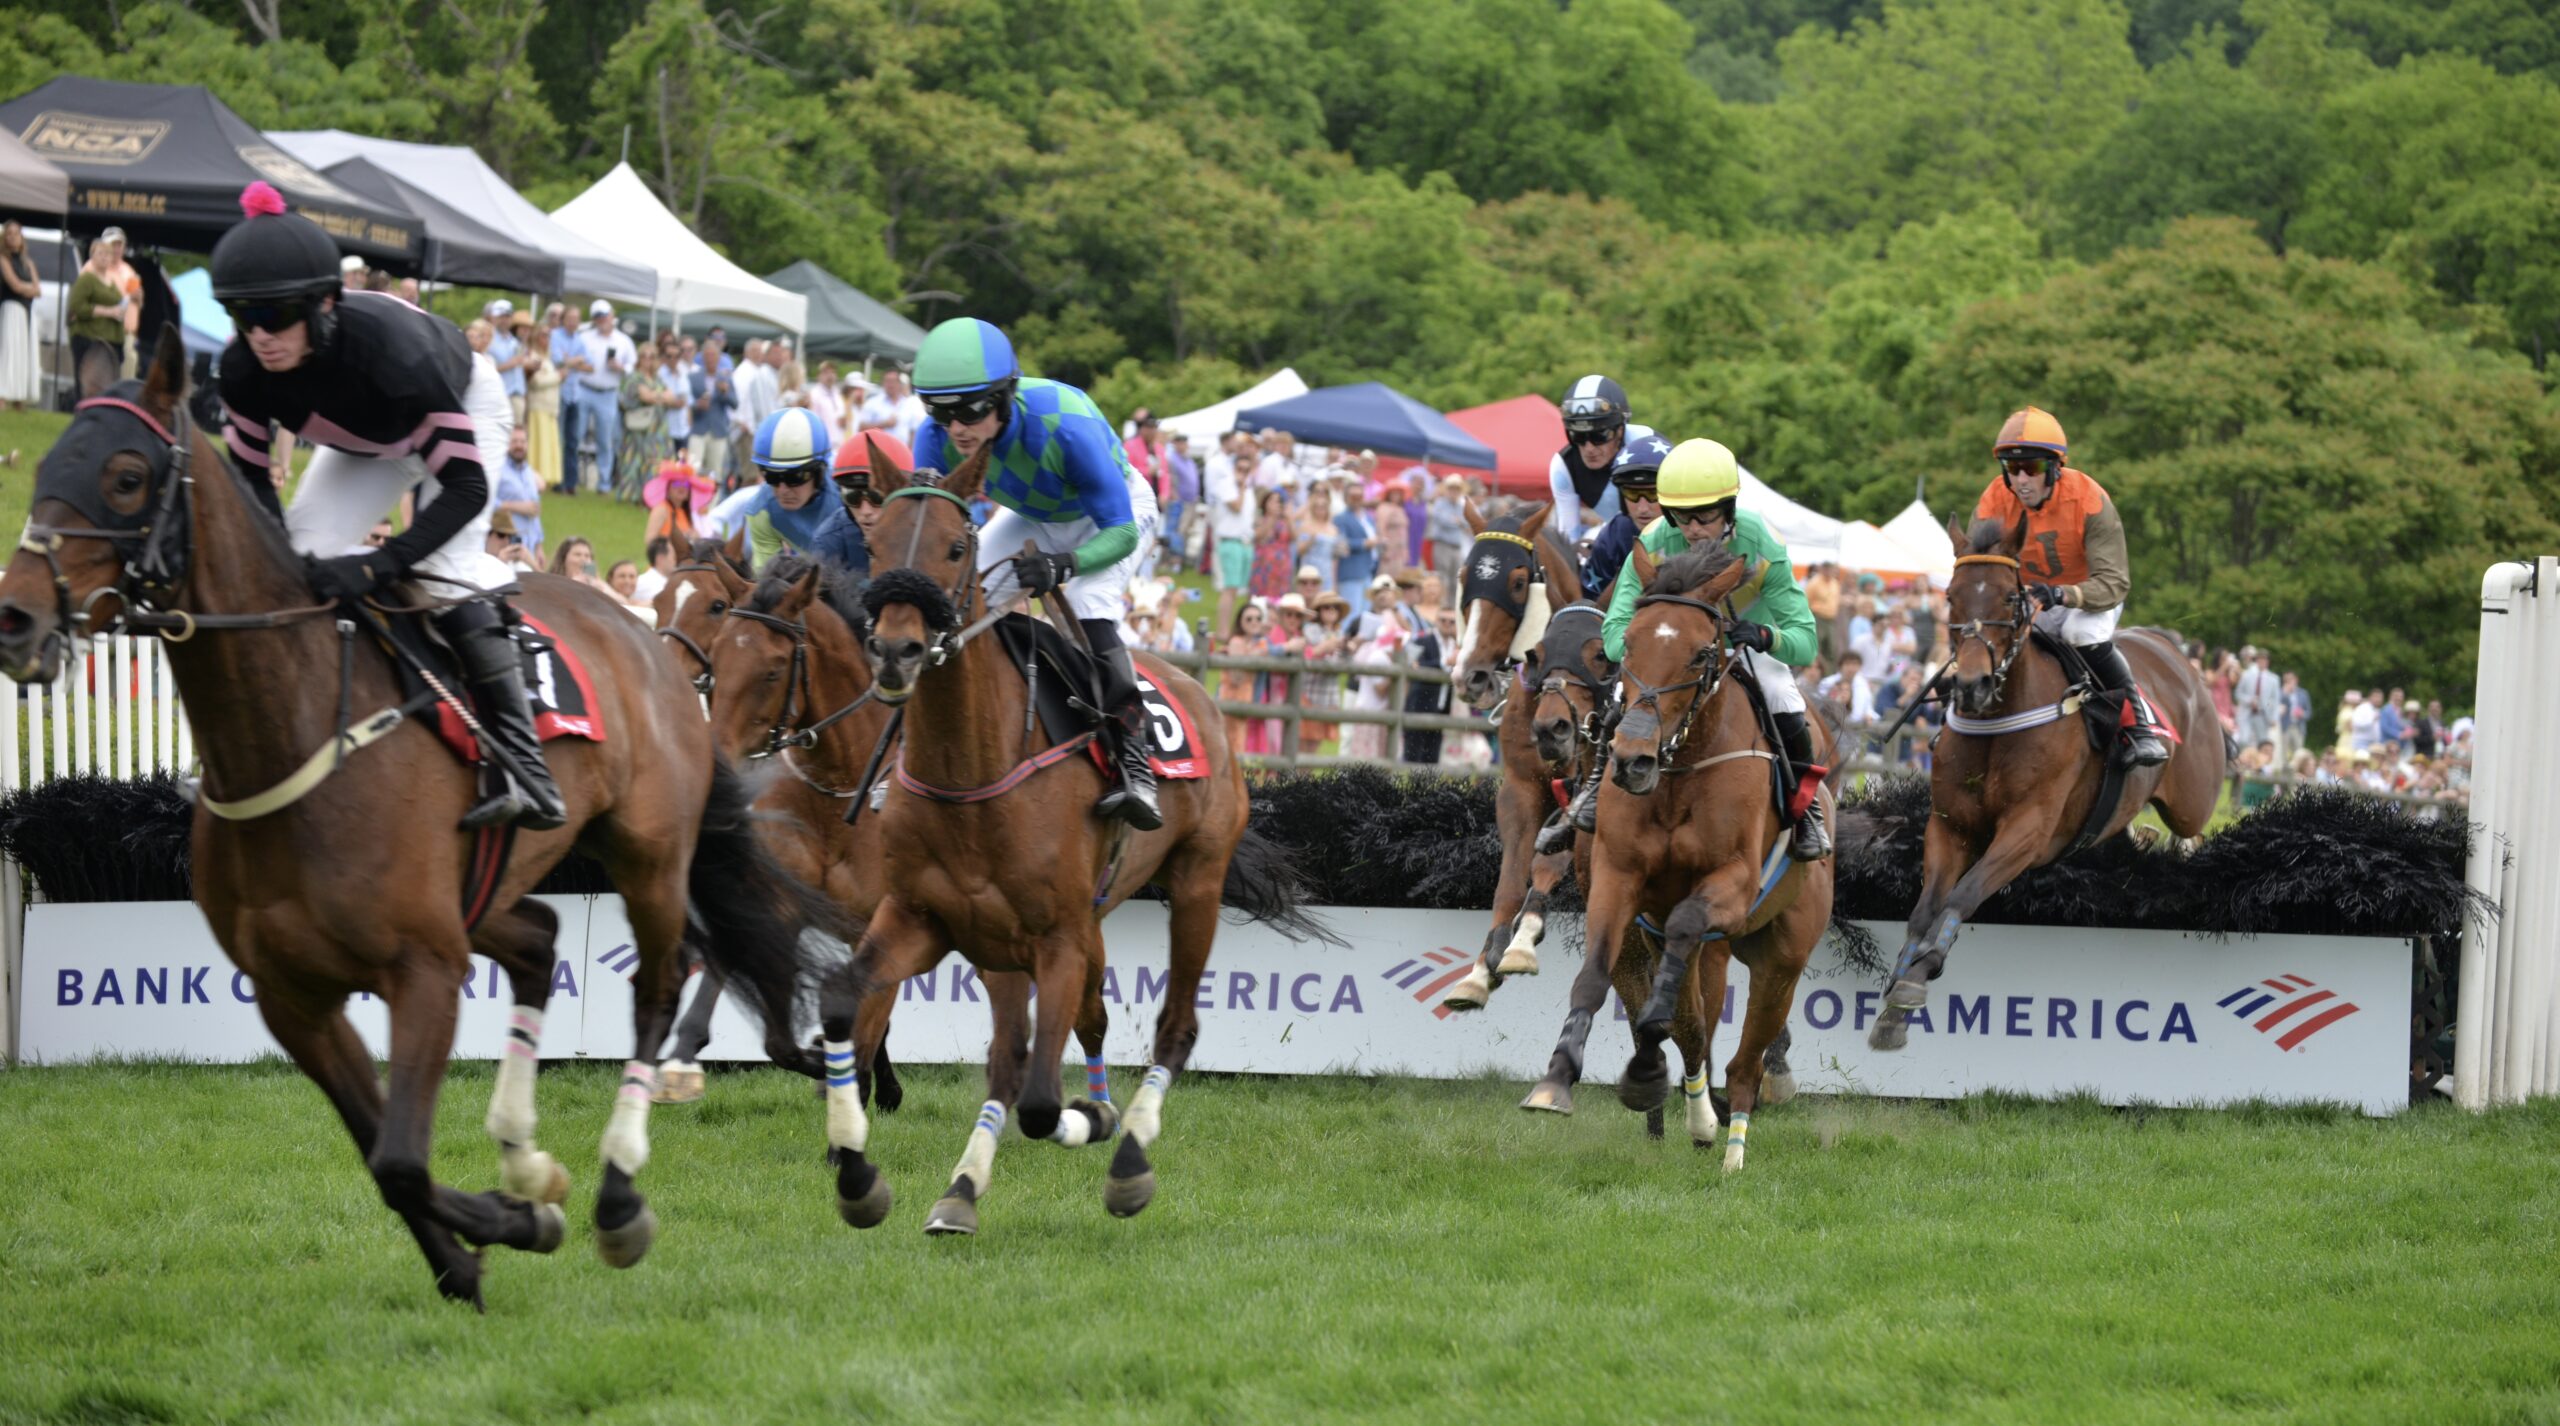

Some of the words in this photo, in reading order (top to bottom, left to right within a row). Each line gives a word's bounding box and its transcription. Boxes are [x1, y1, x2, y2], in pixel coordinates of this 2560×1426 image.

[2026, 531, 2063, 578] J
[1138, 681, 1184, 752] 5
[57, 967, 210, 1006] BANK
[1101, 966, 1364, 1014] AMERICA
[1804, 989, 1880, 1031] OF
[1904, 994, 2198, 1043] AMERICA
